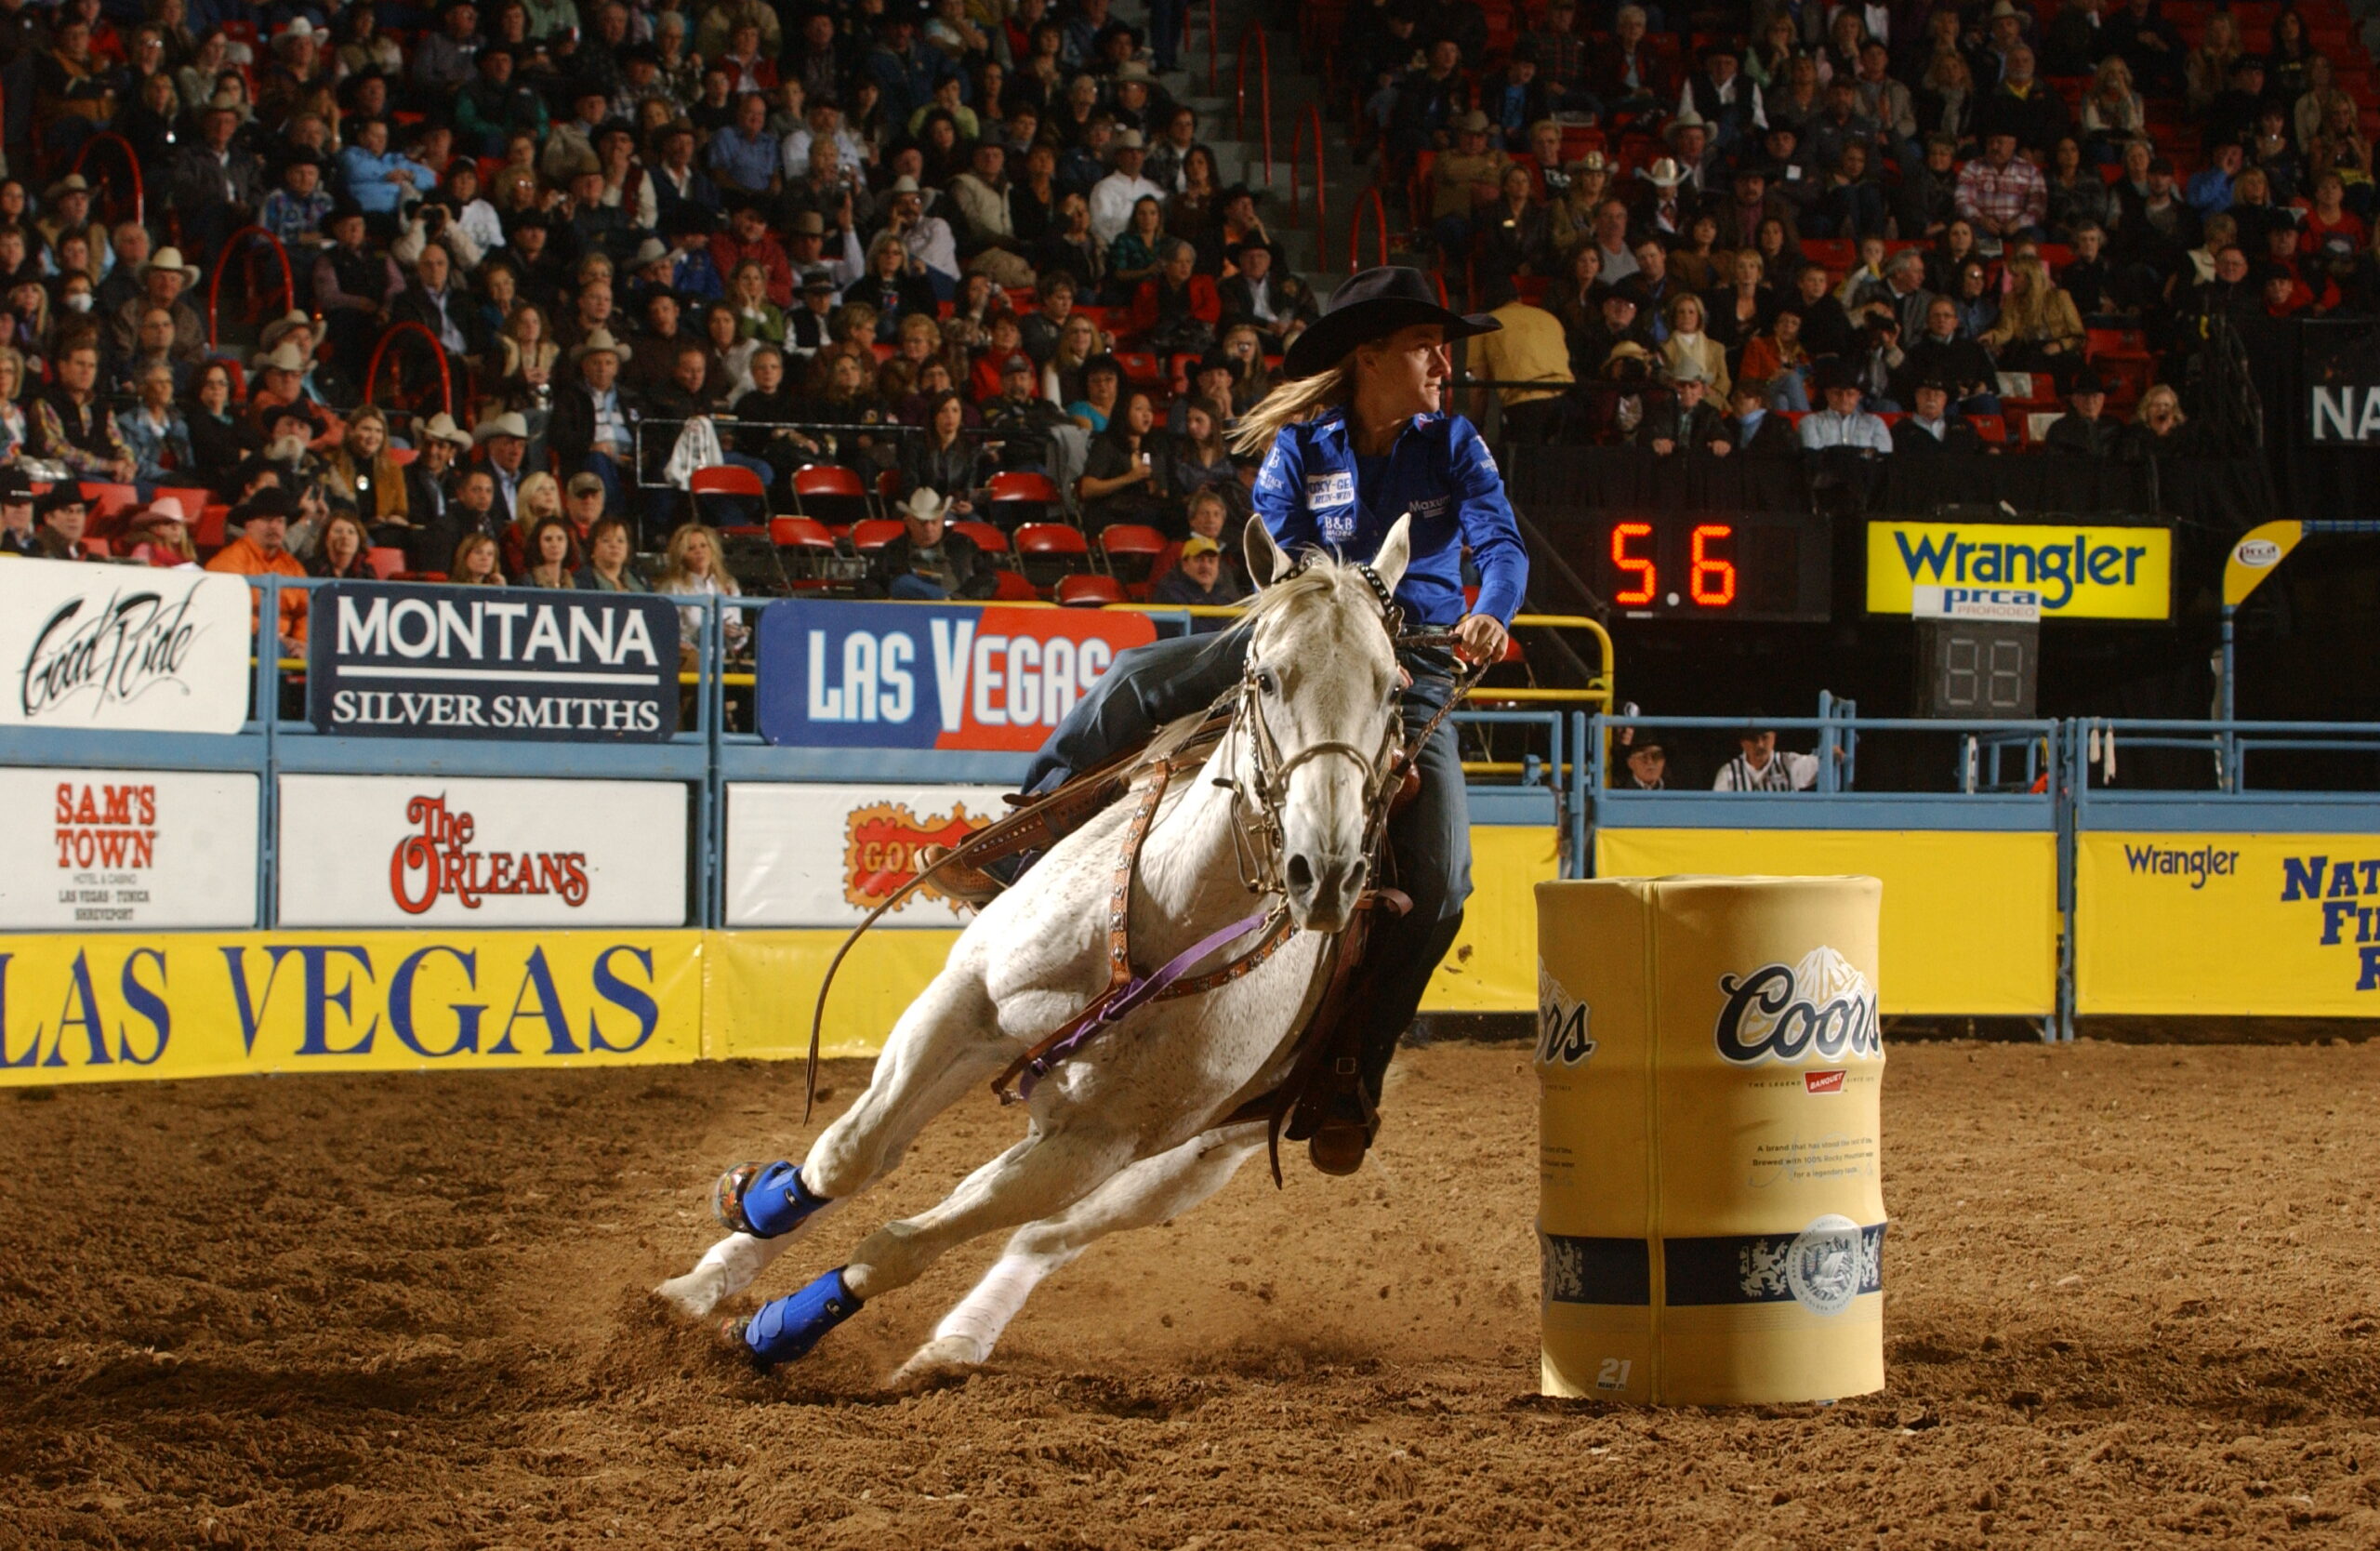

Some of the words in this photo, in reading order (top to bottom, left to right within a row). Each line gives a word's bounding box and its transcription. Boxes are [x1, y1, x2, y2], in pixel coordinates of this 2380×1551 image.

[2312, 385, 2380, 440] NA
[1611, 523, 1736, 605] 5.6
[1893, 531, 2147, 610] Wrangler
[1943, 588, 2036, 613] prca
[1958, 604, 2036, 617] PRORODEO
[337, 595, 660, 666] MONTANA
[808, 630, 915, 724] LAS
[930, 618, 1112, 733] VEGAS
[56, 782, 156, 826] SAM'S
[406, 789, 475, 850] The
[55, 828, 156, 868] TOWN
[863, 841, 925, 873] GOL
[2123, 843, 2240, 890] Wrangler
[390, 834, 588, 914] ORLEANS
[2320, 901, 2380, 946] FI
[0, 945, 171, 1068] LAS
[218, 944, 659, 1058] VEGAS
[1716, 963, 1879, 1061] Coors
[1810, 1072, 1844, 1090] BANQUET
[1805, 1156, 1822, 1164] 100%
[1598, 1358, 1632, 1383] 21
